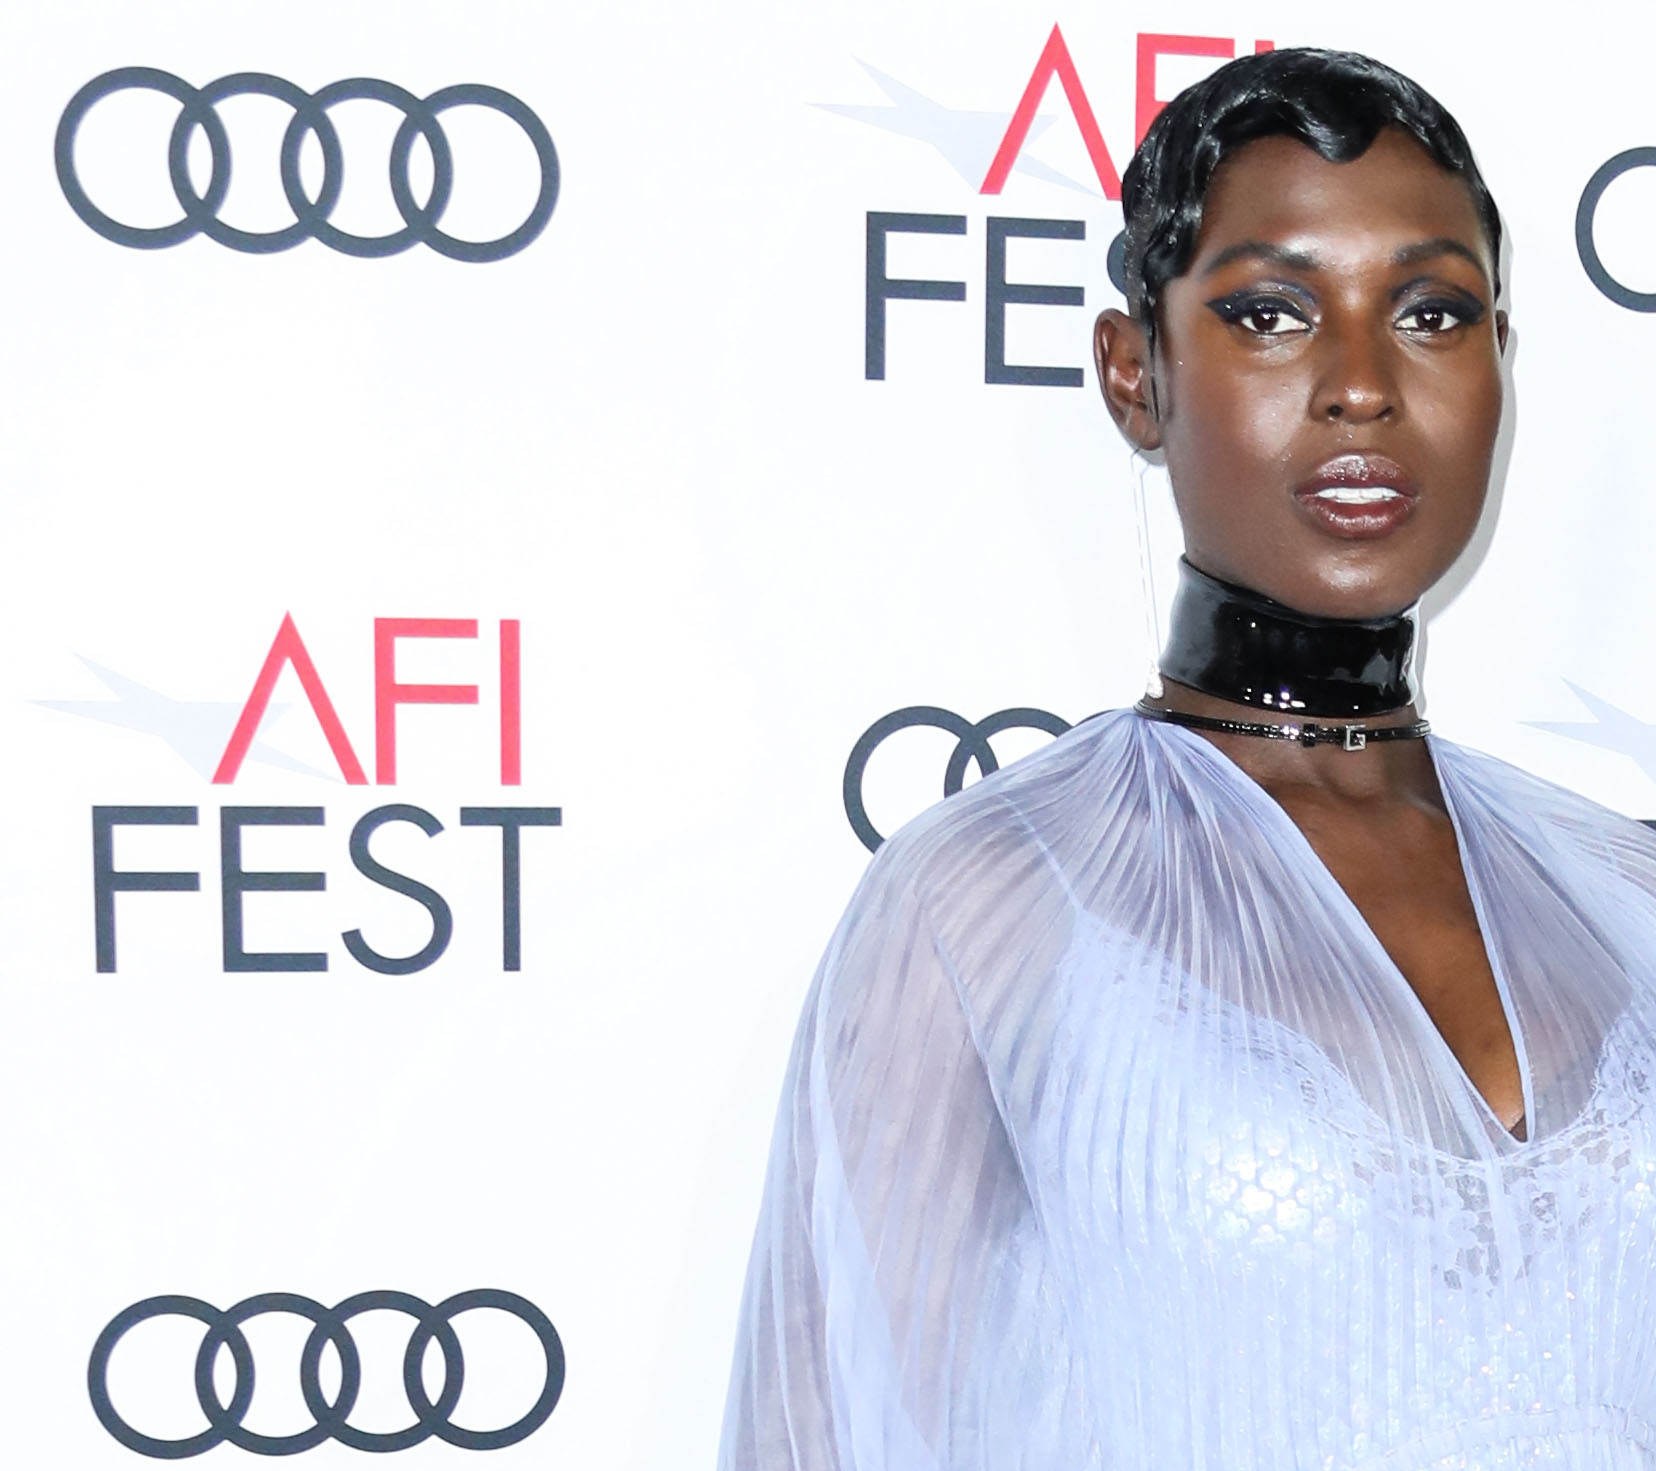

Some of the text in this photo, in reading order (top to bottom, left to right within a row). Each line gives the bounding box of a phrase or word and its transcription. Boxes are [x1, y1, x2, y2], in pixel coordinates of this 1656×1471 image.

[979, 21, 1275, 201] AF
[865, 211, 1126, 388] FE
[210, 610, 521, 786] AFI
[90, 803, 563, 977] FEST
